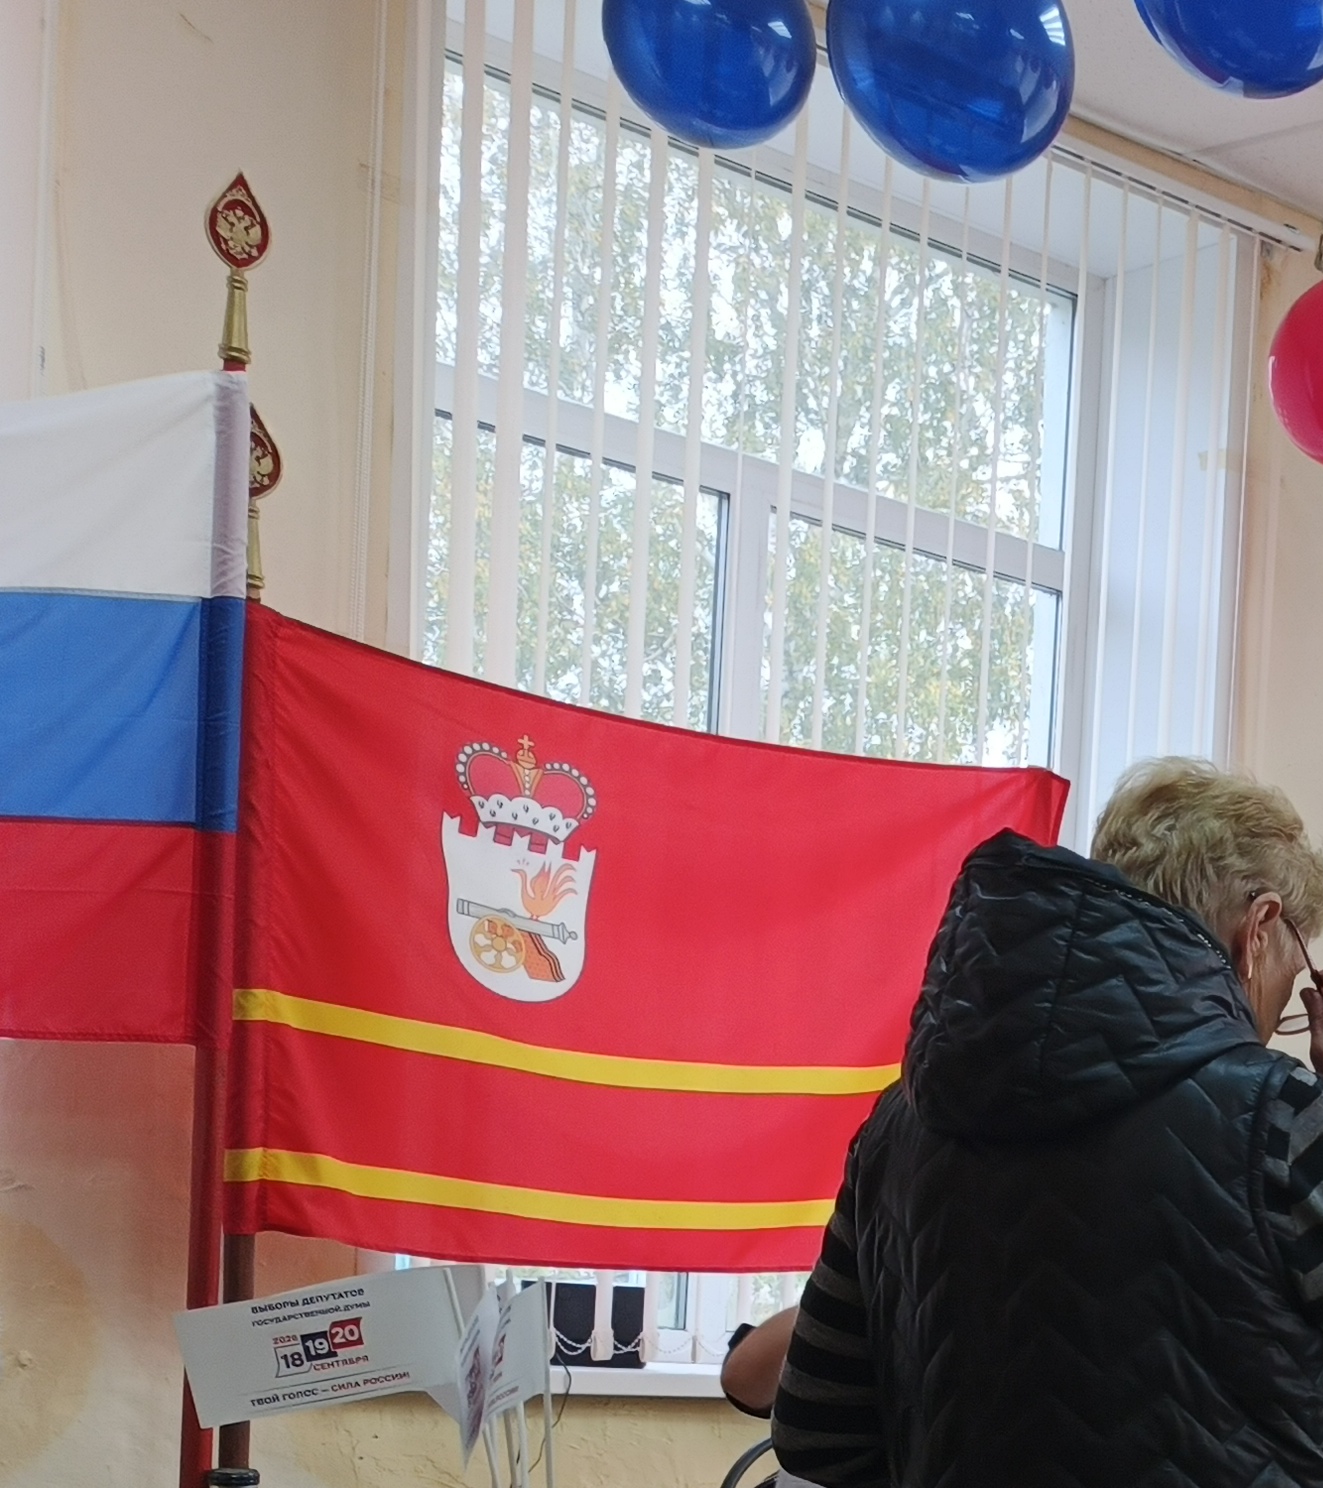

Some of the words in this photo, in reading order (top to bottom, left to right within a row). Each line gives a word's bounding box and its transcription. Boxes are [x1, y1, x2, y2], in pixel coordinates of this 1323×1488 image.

[251, 1299, 300, 1314] ВЫБОРЫ
[301, 1288, 365, 1307] ДЕПУТАТОВ
[280, 1351, 304, 1369] 18
[305, 1338, 330, 1356] 19
[331, 1324, 359, 1344] 20
[313, 1355, 369, 1371] СЕНТЯБРЯ
[251, 1394, 280, 1407] ТВОЙ
[282, 1388, 319, 1401] ГОЛОС
[331, 1381, 361, 1393] СИЛА
